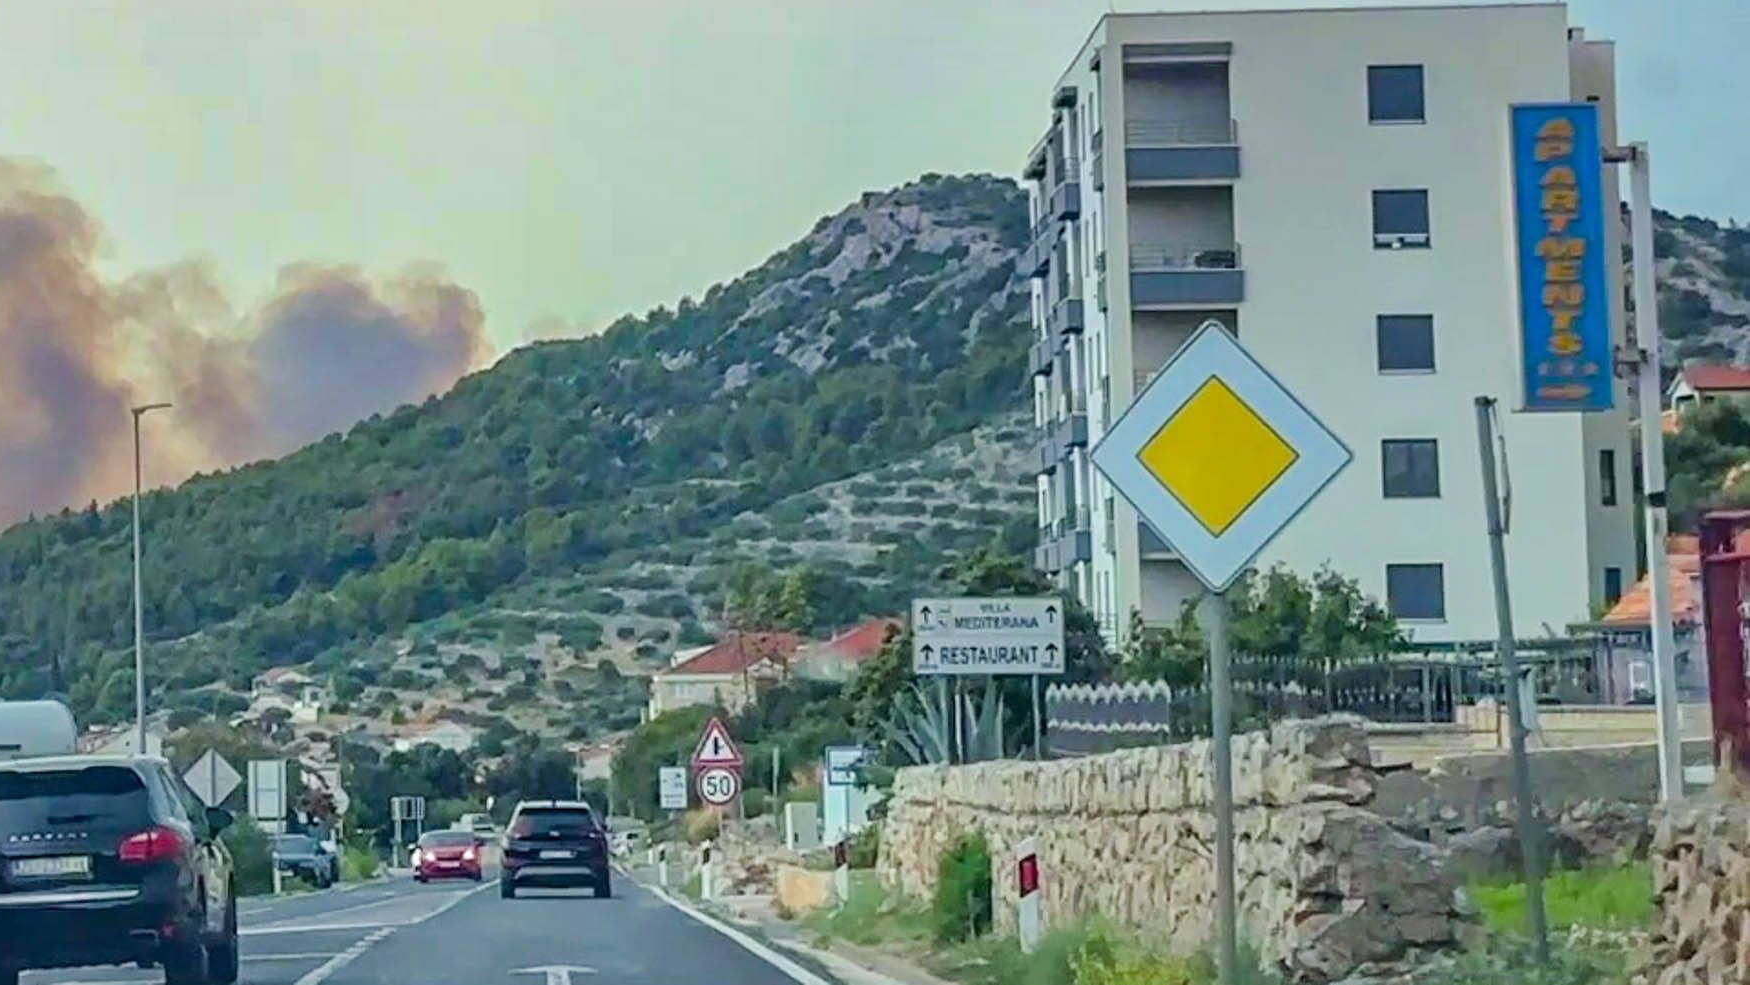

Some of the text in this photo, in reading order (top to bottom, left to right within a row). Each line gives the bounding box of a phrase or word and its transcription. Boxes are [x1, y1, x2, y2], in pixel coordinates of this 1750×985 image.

[954, 616, 1039, 629] MEDITERANA
[940, 646, 1039, 665] RESTAURANT
[706, 776, 731, 797] 50
